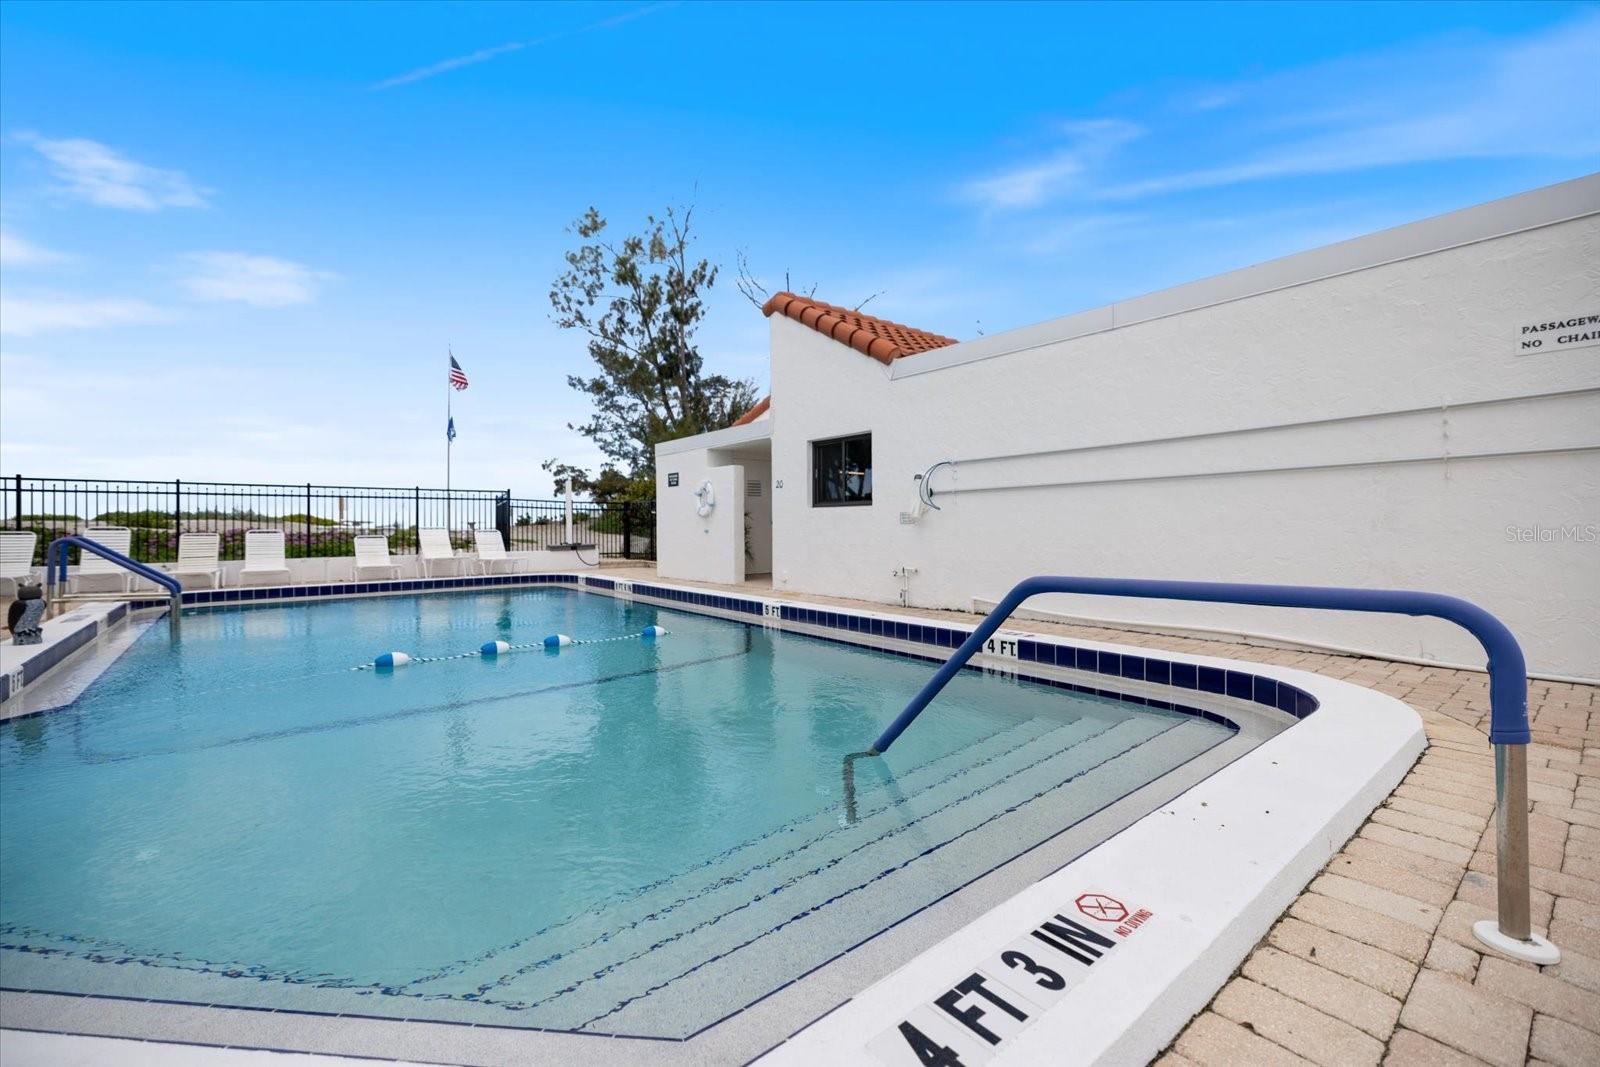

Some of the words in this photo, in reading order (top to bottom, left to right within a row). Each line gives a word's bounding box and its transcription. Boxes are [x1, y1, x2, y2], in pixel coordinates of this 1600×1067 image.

[1521, 315, 1600, 334] PASSAGEW
[1521, 339, 1542, 349] NO
[1557, 331, 1600, 344] CHAI
[987, 639, 996, 654] 4
[1000, 640, 1017, 657] FT.
[1030, 914, 1117, 967] IN
[1113, 925, 1133, 938] NO
[1124, 908, 1153, 929] DIVING
[1001, 950, 1066, 991] 3
[933, 972, 1029, 1046] FT
[898, 1020, 967, 1067] 4
